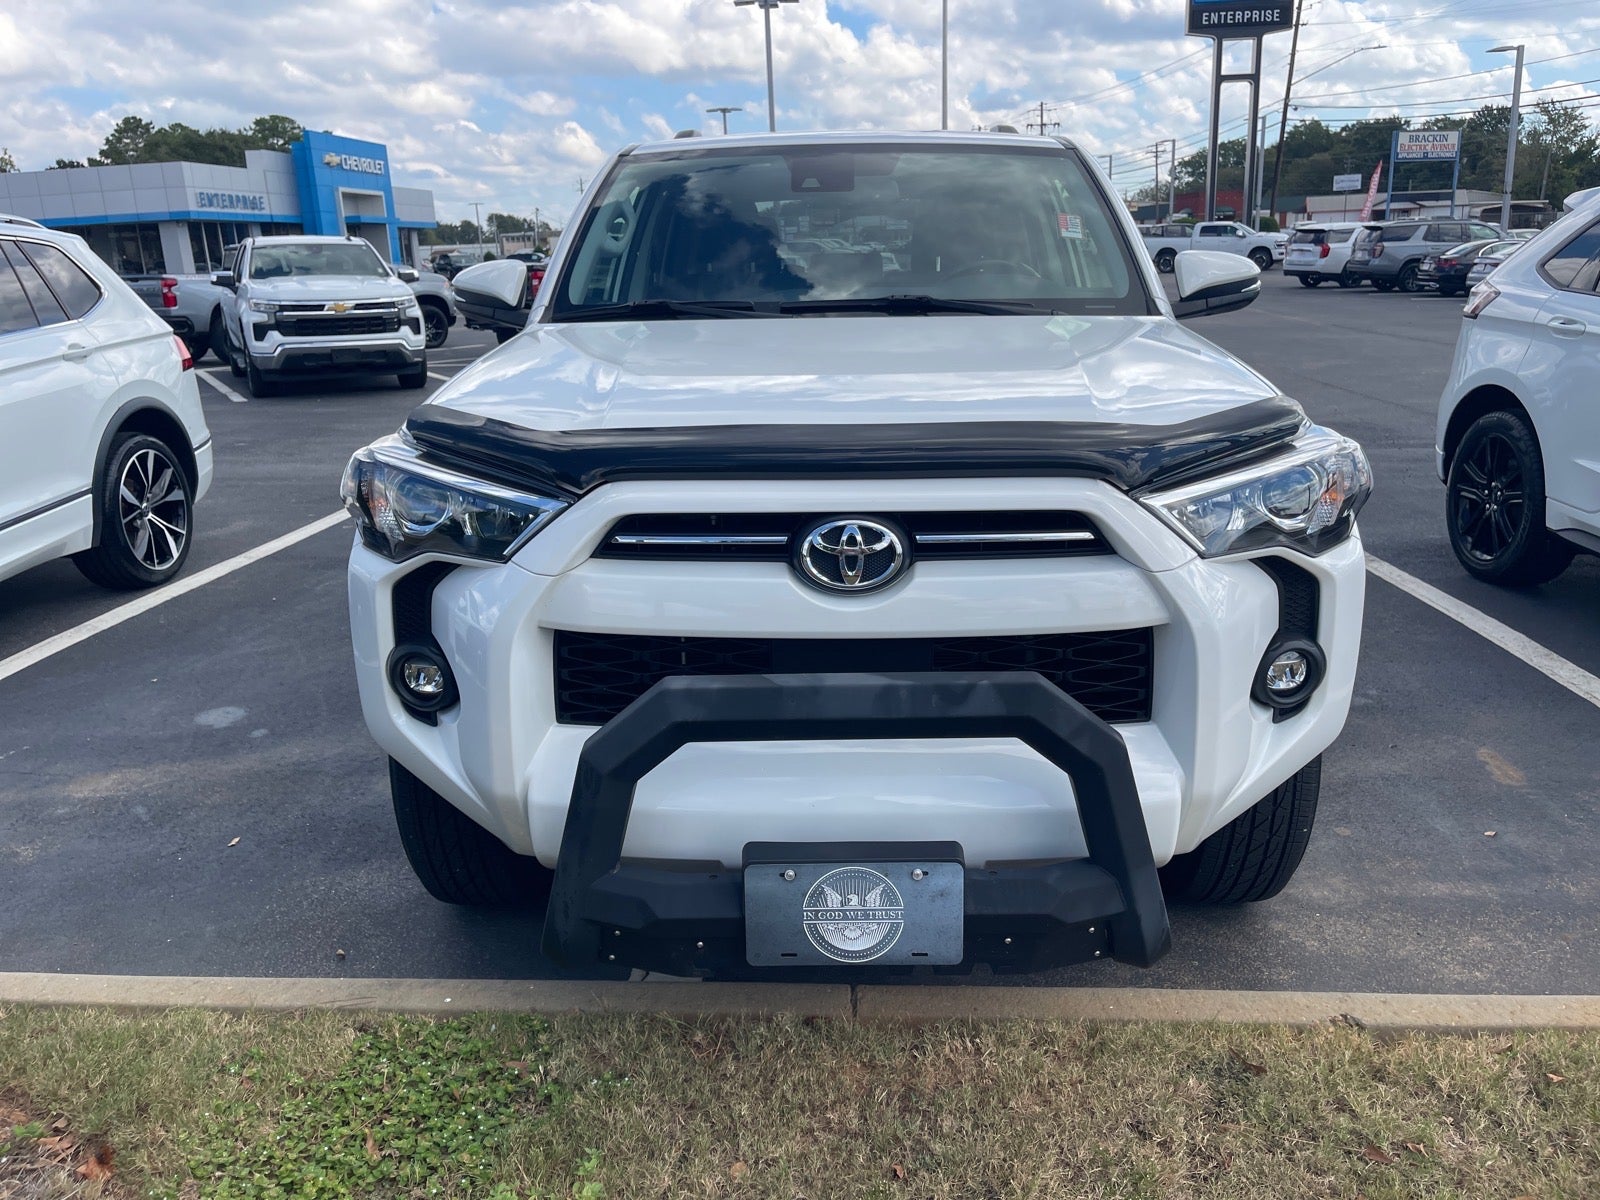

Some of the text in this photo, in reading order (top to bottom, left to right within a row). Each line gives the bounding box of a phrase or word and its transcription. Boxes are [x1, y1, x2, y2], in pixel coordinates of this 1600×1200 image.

[1202, 9, 1281, 25] ENTERPRISE
[1409, 134, 1448, 143] BRACKIN
[1400, 143, 1456, 152] ELECTRIC AVENUE
[341, 154, 385, 175] CHEVROLET
[196, 191, 266, 212] ENTERPRISE
[803, 910, 904, 920] IN GOD WE TRUST
